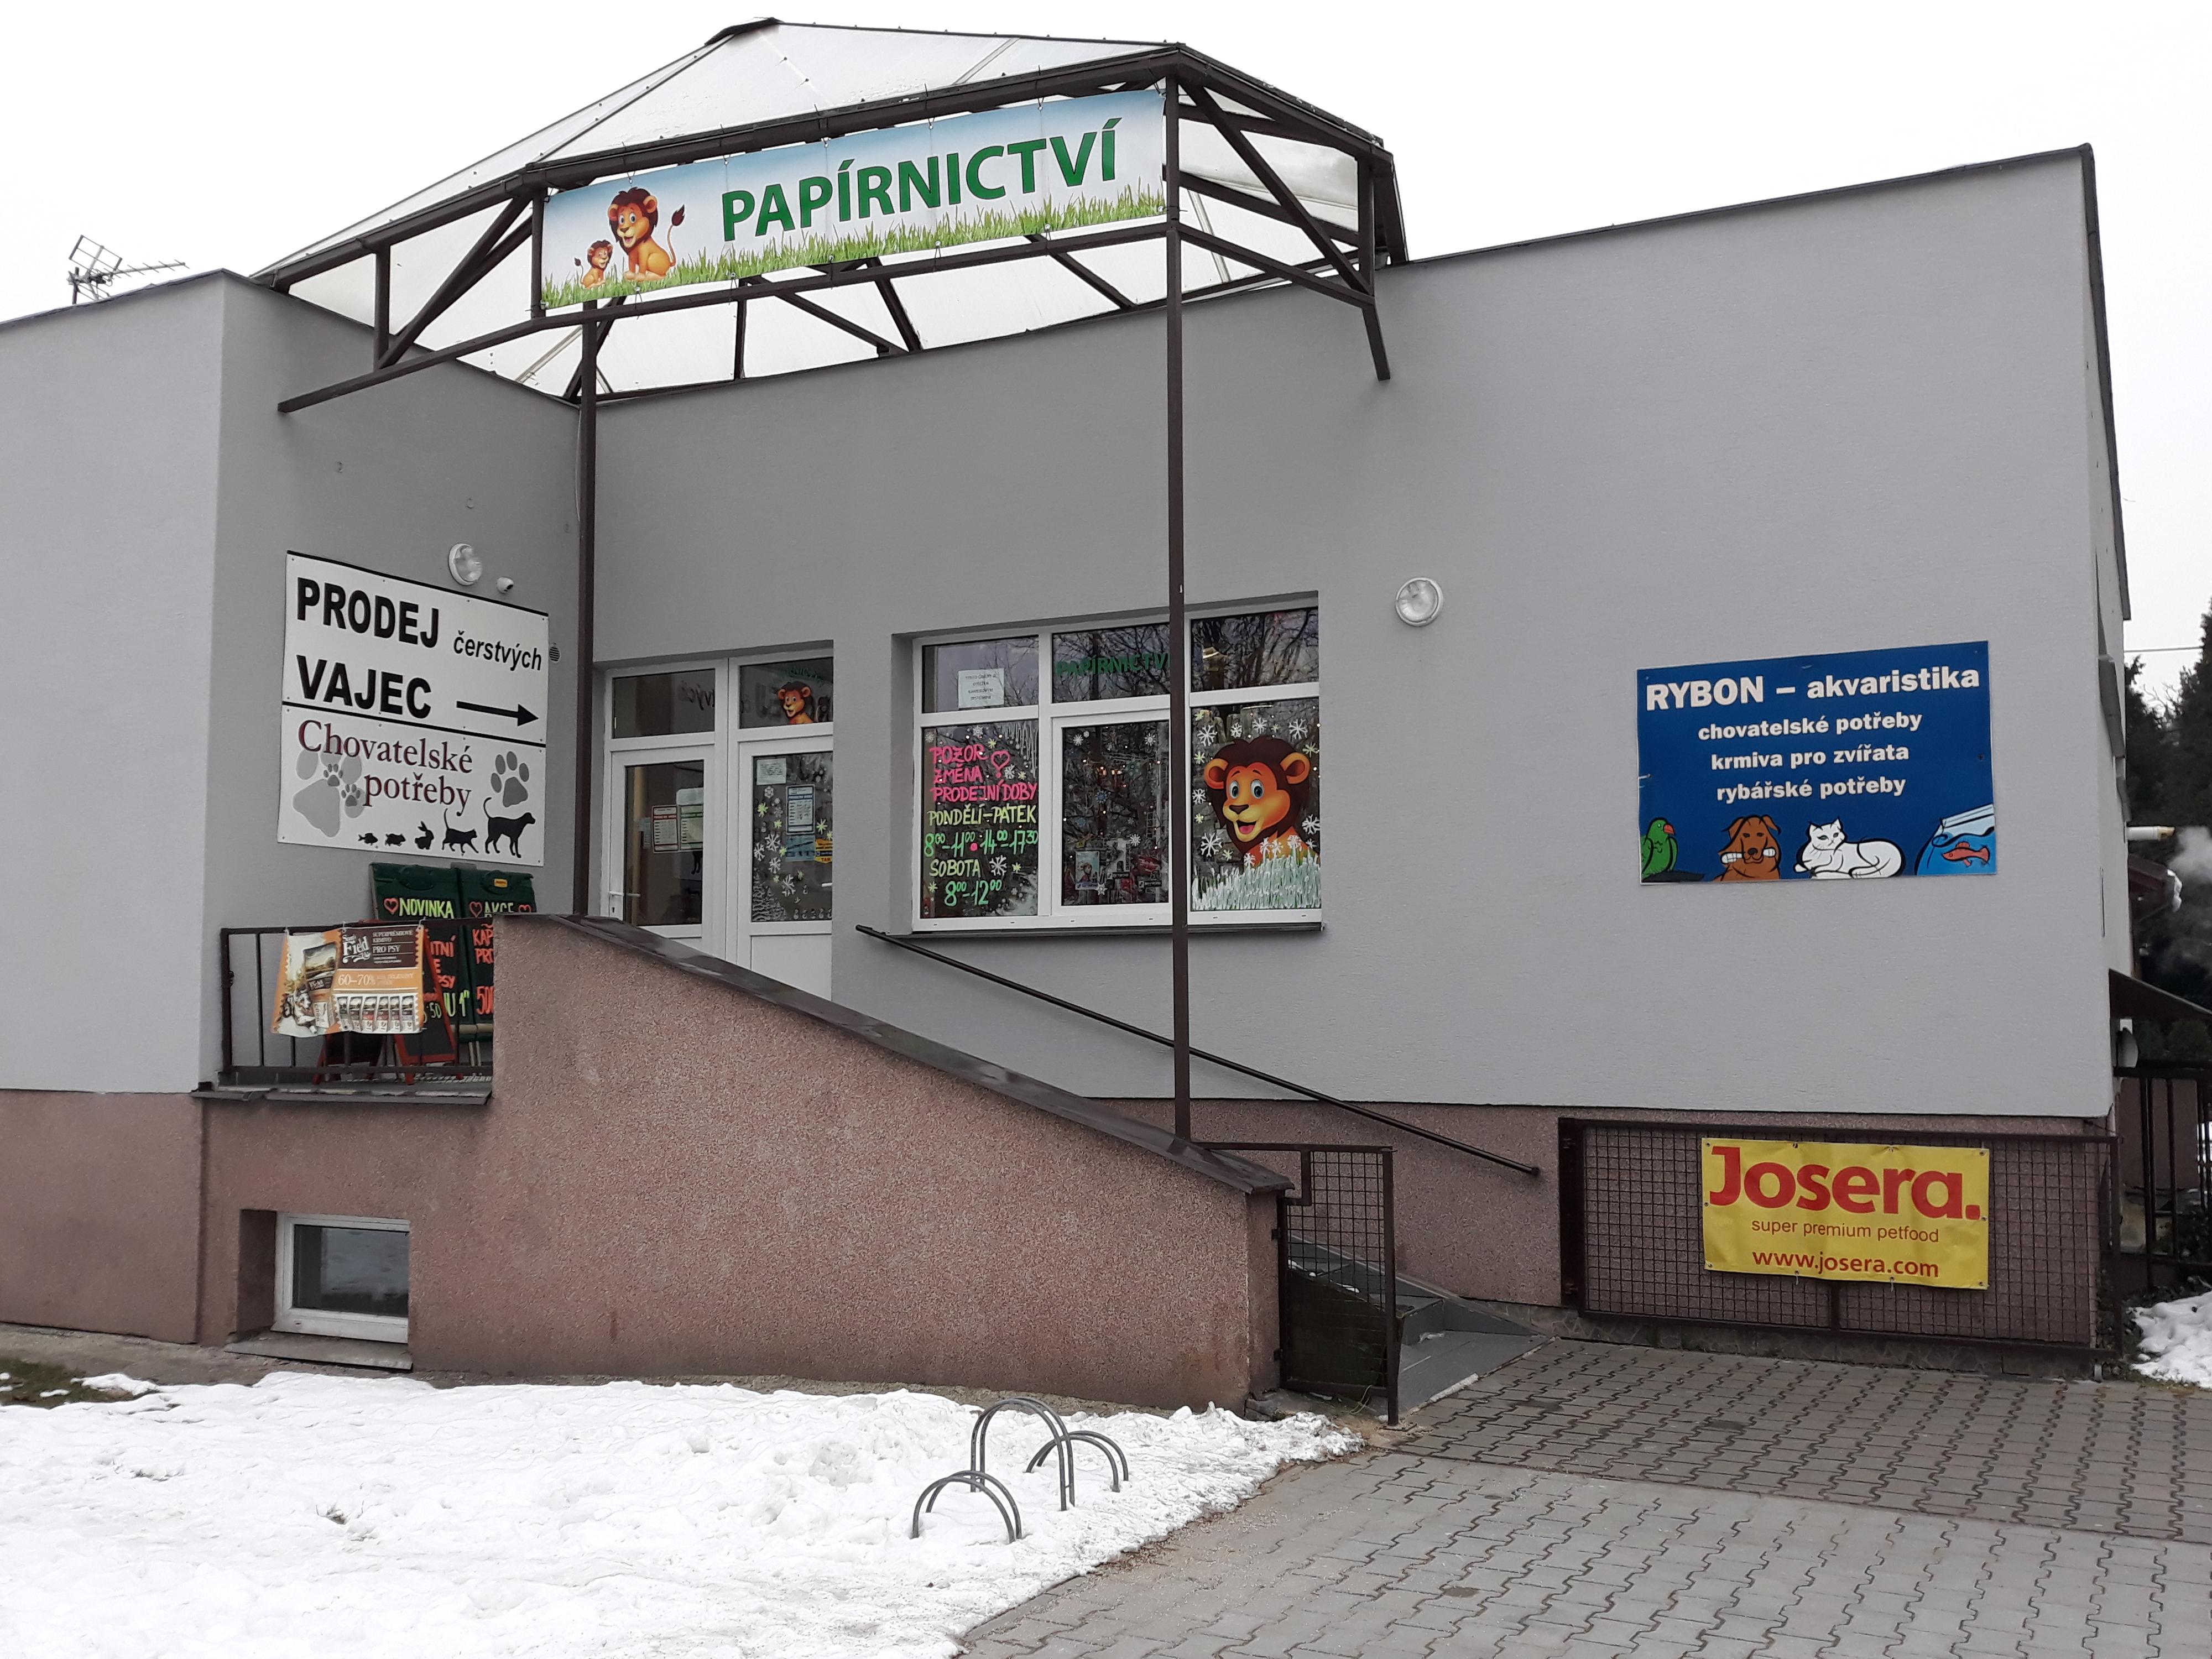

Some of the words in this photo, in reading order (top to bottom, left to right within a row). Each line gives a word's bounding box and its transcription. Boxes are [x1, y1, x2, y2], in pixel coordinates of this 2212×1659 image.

[722, 117, 1123, 242] PAPÍRNICTVÍ
[297, 577, 439, 648] PRODEJ
[453, 630, 542, 671] čerstvých
[296, 654, 431, 719] VAJEC
[1646, 675, 1765, 711] RYBON
[1806, 665, 1980, 700] akvaristika
[1697, 716, 1829, 740] chovatelské
[1835, 712, 1923, 735] potřeby
[298, 719, 473, 774] Chovatelské
[930, 744, 989, 764] POZOR
[1711, 751, 1783, 770] krmiva
[1790, 752, 1827, 769] pro
[1833, 744, 1910, 764] zvířata
[933, 763, 983, 784] ZMĚNA
[362, 771, 472, 817] potřeby
[930, 780, 1004, 802] PRODEJNÍ
[1003, 782, 1037, 801] DOBY
[1717, 779, 1813, 804] rybářské
[1819, 776, 1907, 800] potřeby
[929, 859, 981, 878] SOBOTA
[399, 898, 455, 919] NOVINKA
[343, 936, 369, 956] Field
[387, 945, 401, 953] PSY
[1709, 1146, 1981, 1221] Josera.
[1751, 1220, 1798, 1235] super
[1803, 1223, 1872, 1238] premium
[1877, 1225, 1939, 1243] petfood
[1752, 1251, 1939, 1277] www.josera.com
